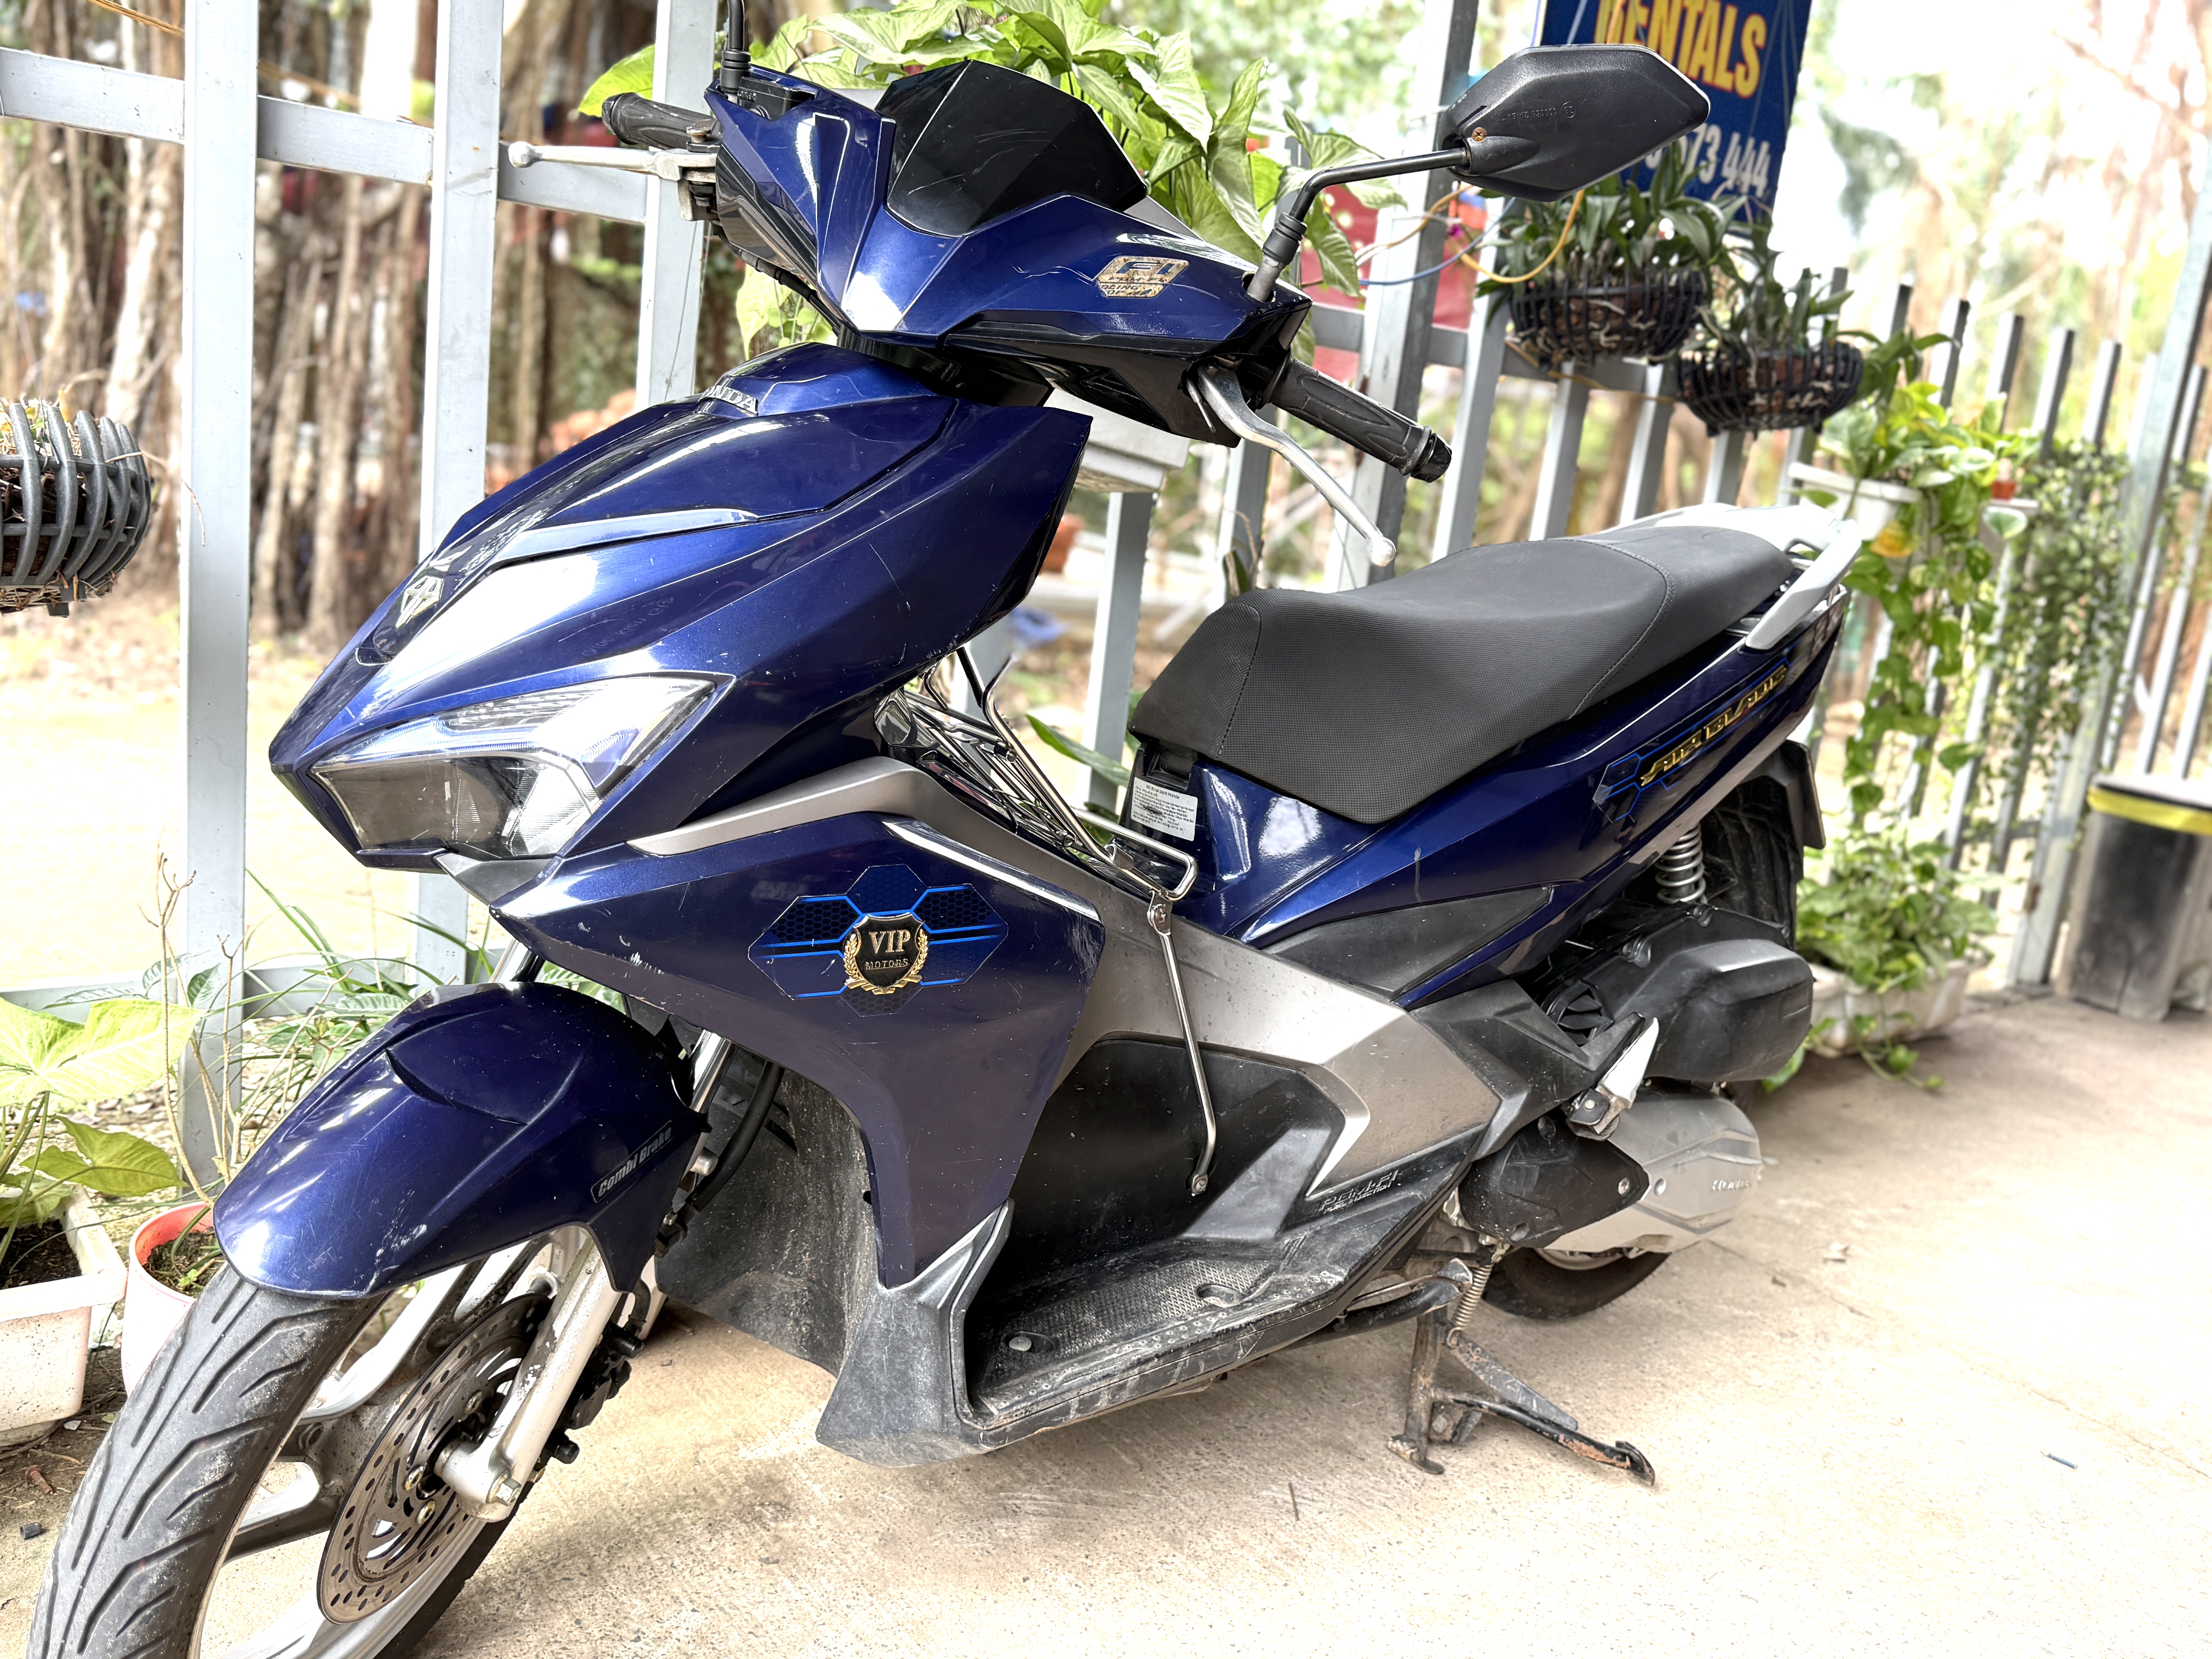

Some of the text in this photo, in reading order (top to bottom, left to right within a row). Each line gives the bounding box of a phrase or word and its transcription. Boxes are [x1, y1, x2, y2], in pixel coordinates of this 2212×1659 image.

[1721, 132, 1771, 198] 444
[698, 385, 757, 414] ONDA
[869, 929, 910, 954] VIP
[866, 958, 908, 969] MOTORS
[598, 1127, 672, 1197] Combi Brake
